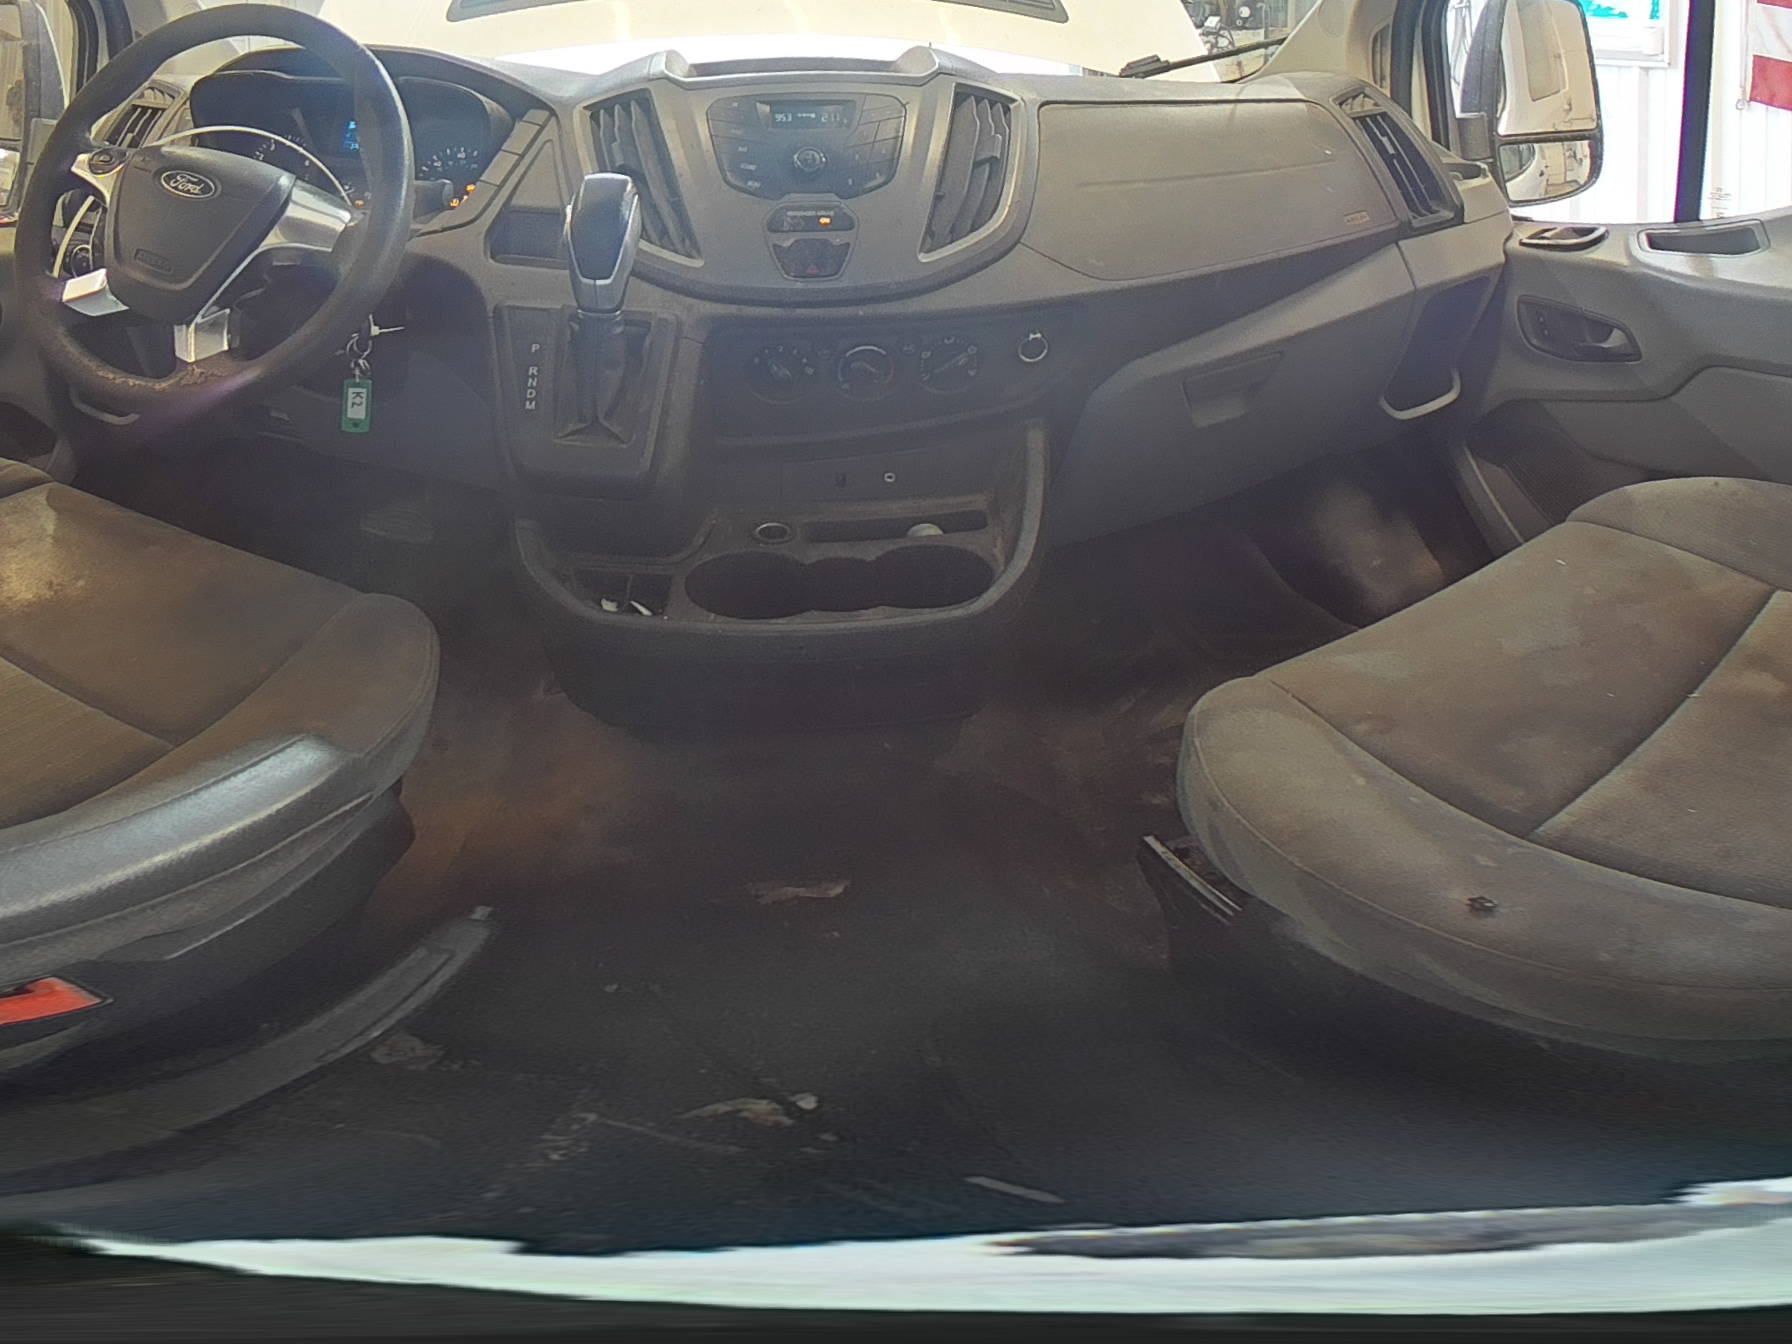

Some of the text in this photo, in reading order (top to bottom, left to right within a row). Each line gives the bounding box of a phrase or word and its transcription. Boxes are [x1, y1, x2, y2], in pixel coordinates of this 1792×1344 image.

[169, 173, 205, 195] Ford
[531, 343, 541, 353] P
[528, 366, 539, 375] R
[528, 377, 538, 387] N
[526, 388, 536, 398] D
[351, 391, 365, 409] K2
[525, 400, 536, 409] M
